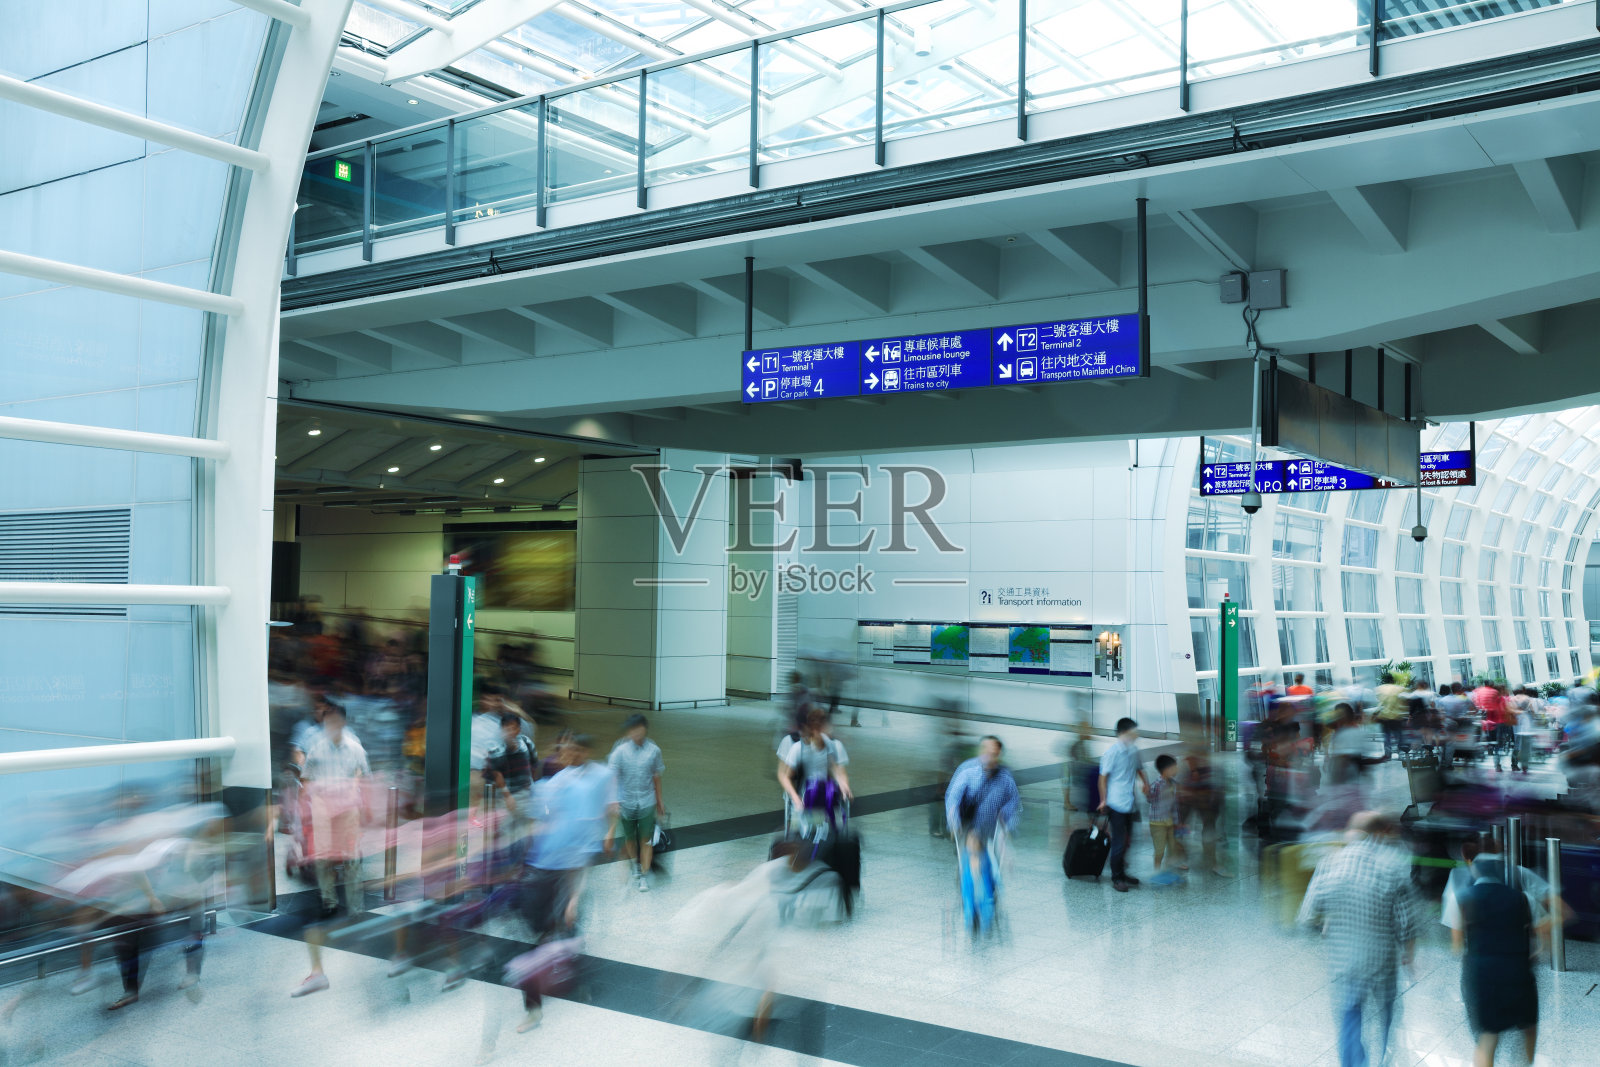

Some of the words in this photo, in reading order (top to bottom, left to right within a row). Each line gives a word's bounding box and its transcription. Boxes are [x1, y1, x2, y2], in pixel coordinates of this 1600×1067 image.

[1040, 318, 1120, 338] 二號客運大樓
[903, 335, 963, 353] 專車候車處
[1018, 333, 1036, 347] T2
[1041, 340, 1075, 351] Terminal
[1076, 338, 1082, 347] 2
[782, 346, 845, 362] 一號客運大樓
[903, 351, 942, 362] Limousine
[943, 350, 971, 360] lounge
[1040, 350, 1107, 370] 往內地交通
[764, 356, 778, 369] T1
[781, 362, 809, 372] Terminal
[810, 362, 814, 370] 1
[903, 363, 963, 380] 往市區列車
[1041, 370, 1072, 380] Transport
[1073, 369, 1081, 377] to
[1081, 365, 1114, 377] Mainland
[1115, 364, 1136, 374] China
[765, 380, 776, 397] P
[780, 375, 812, 390] 停車場
[813, 379, 824, 395] 4
[903, 380, 925, 390] Trains
[926, 380, 934, 388] to
[935, 379, 950, 389] city
[780, 390, 793, 399] Car
[793, 389, 809, 400] park
[1215, 467, 1226, 476] T2
[1228, 462, 1273, 472] 二號客大樓
[1302, 478, 1311, 490] P
[1339, 477, 1347, 490] 3
[997, 587, 1050, 598] 交通工具資料
[997, 596, 1034, 607] Transport
[1036, 597, 1082, 606] information
